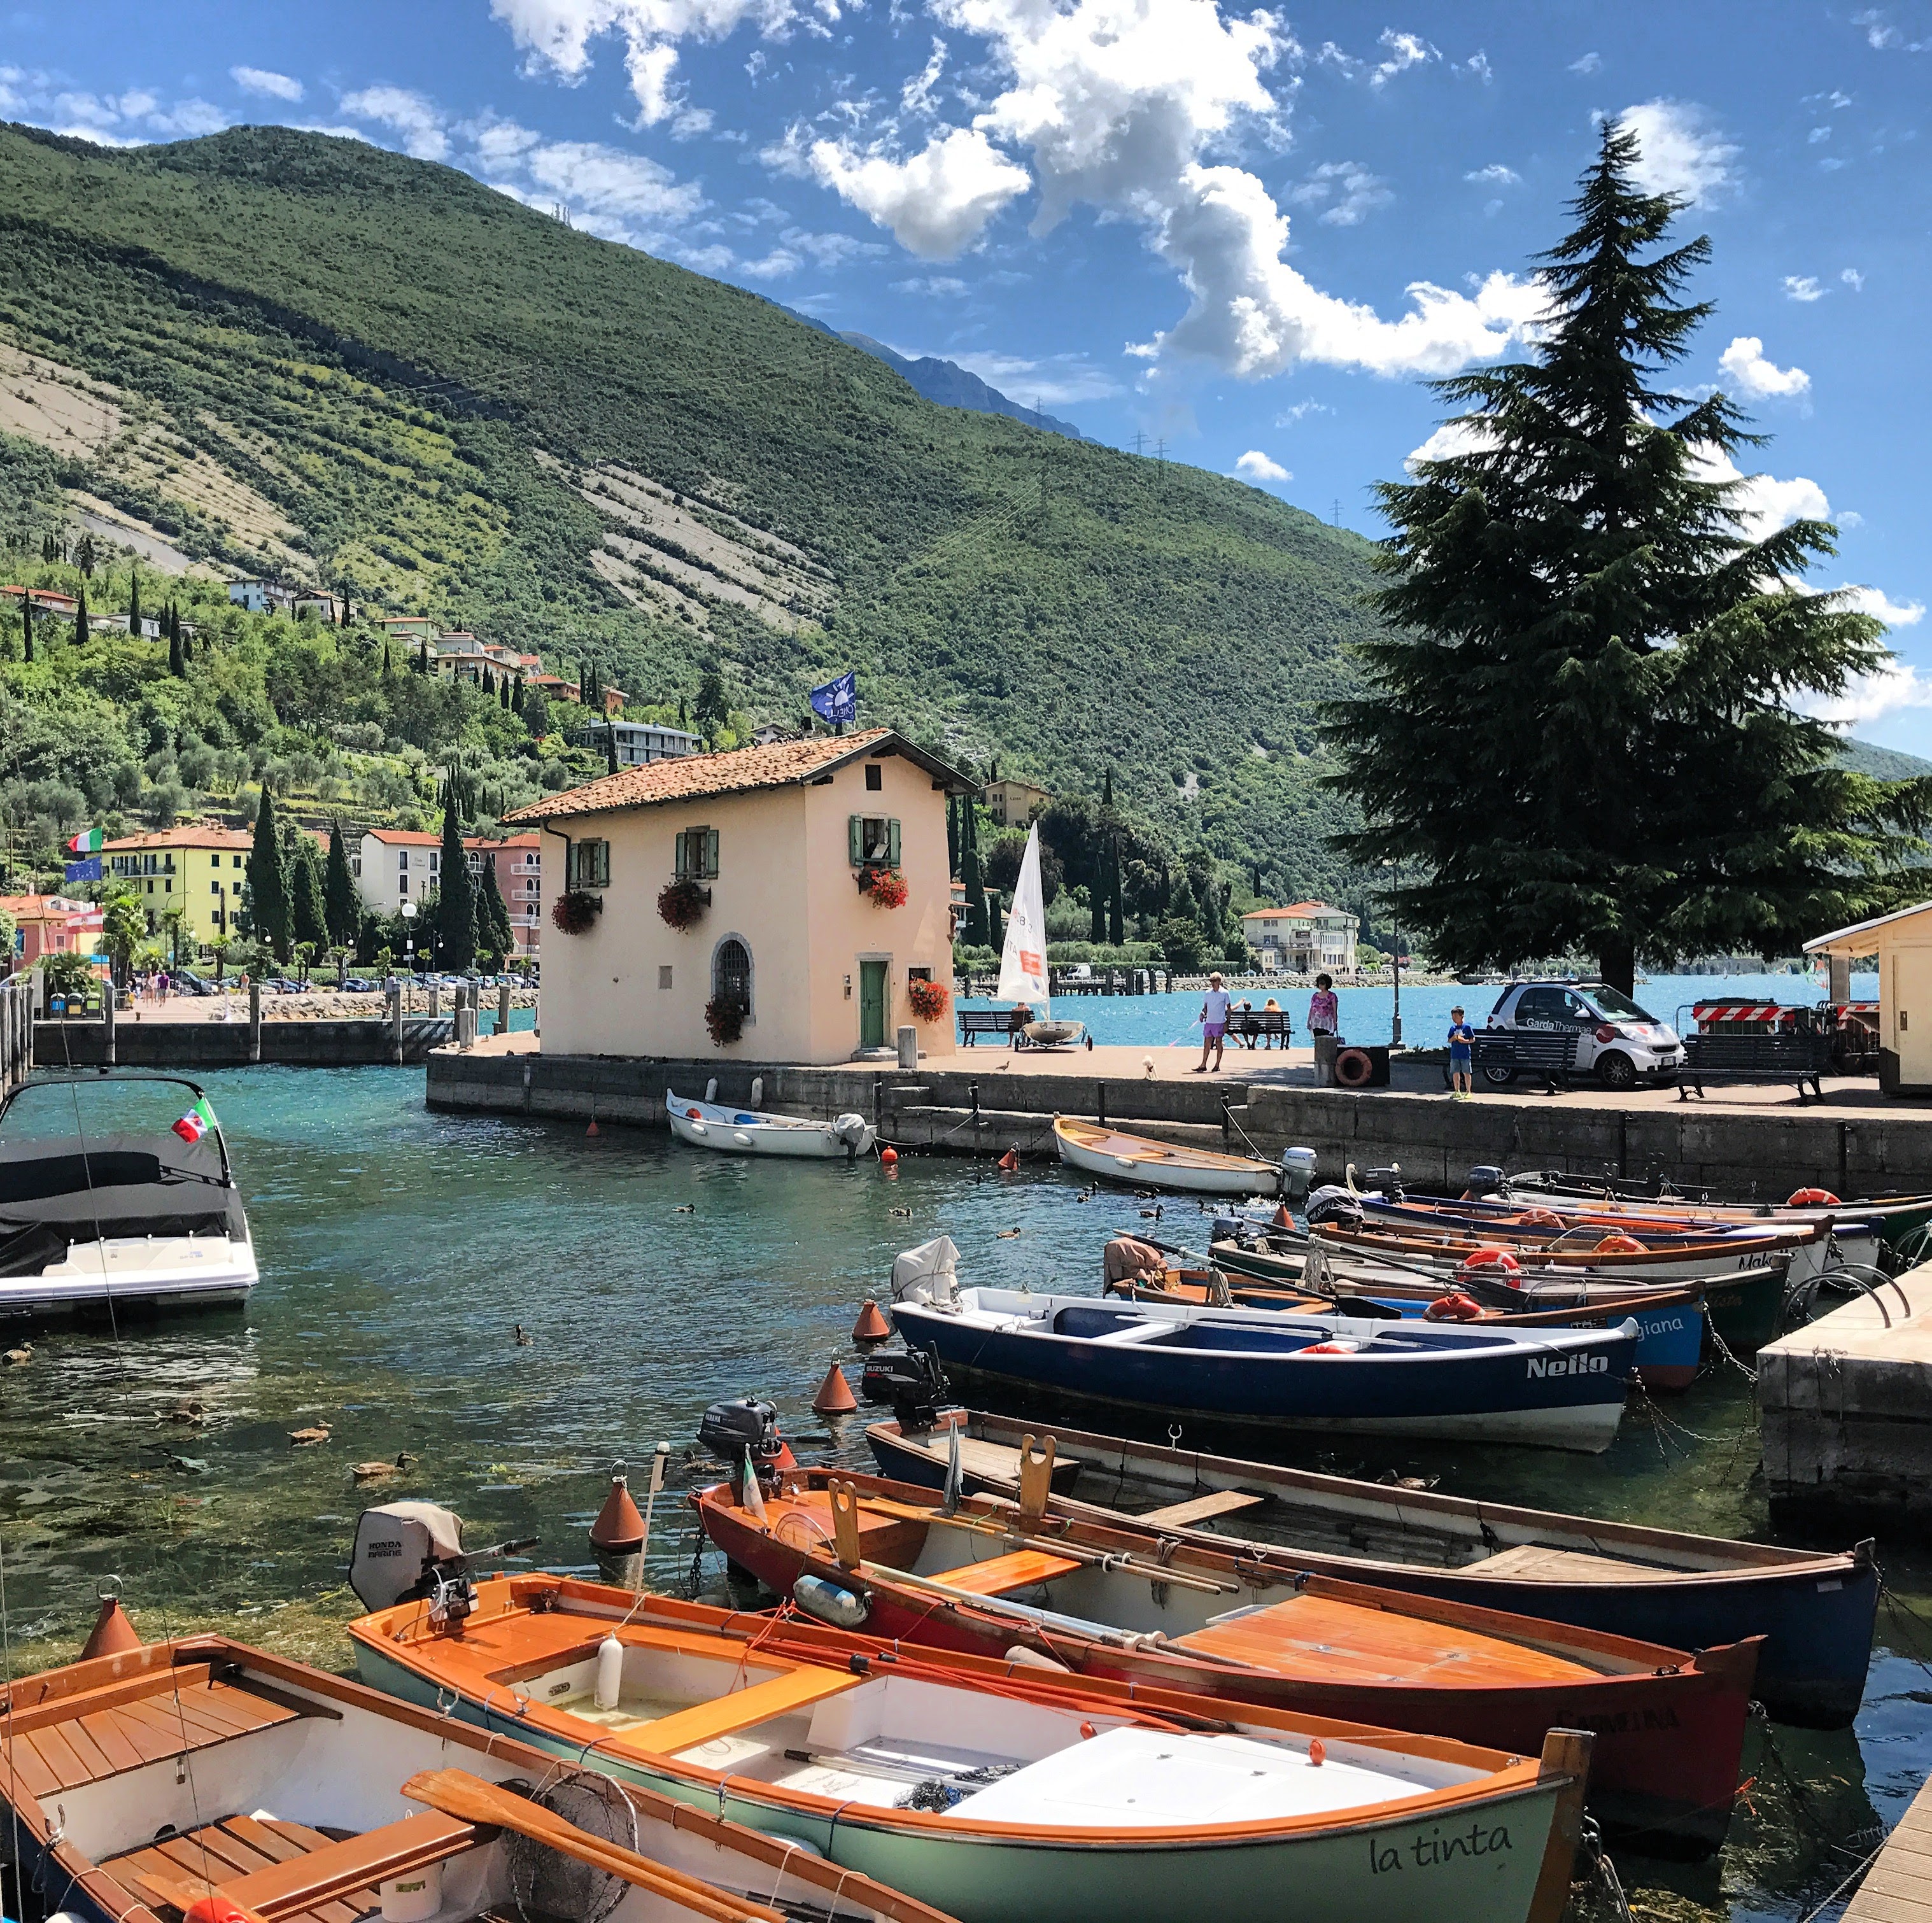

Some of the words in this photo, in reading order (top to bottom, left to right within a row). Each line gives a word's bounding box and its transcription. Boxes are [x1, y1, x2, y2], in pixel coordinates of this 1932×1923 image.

[1006, 938, 1018, 956] ITA
[1527, 1017, 1592, 1034] GardaThermae
[1527, 1353, 1609, 1379] Nello
[705, 1413, 721, 1423] YAMAHA
[369, 1541, 402, 1549] HONDA
[1370, 1838, 1402, 1874] la
[1410, 1824, 1512, 1866] tinta
